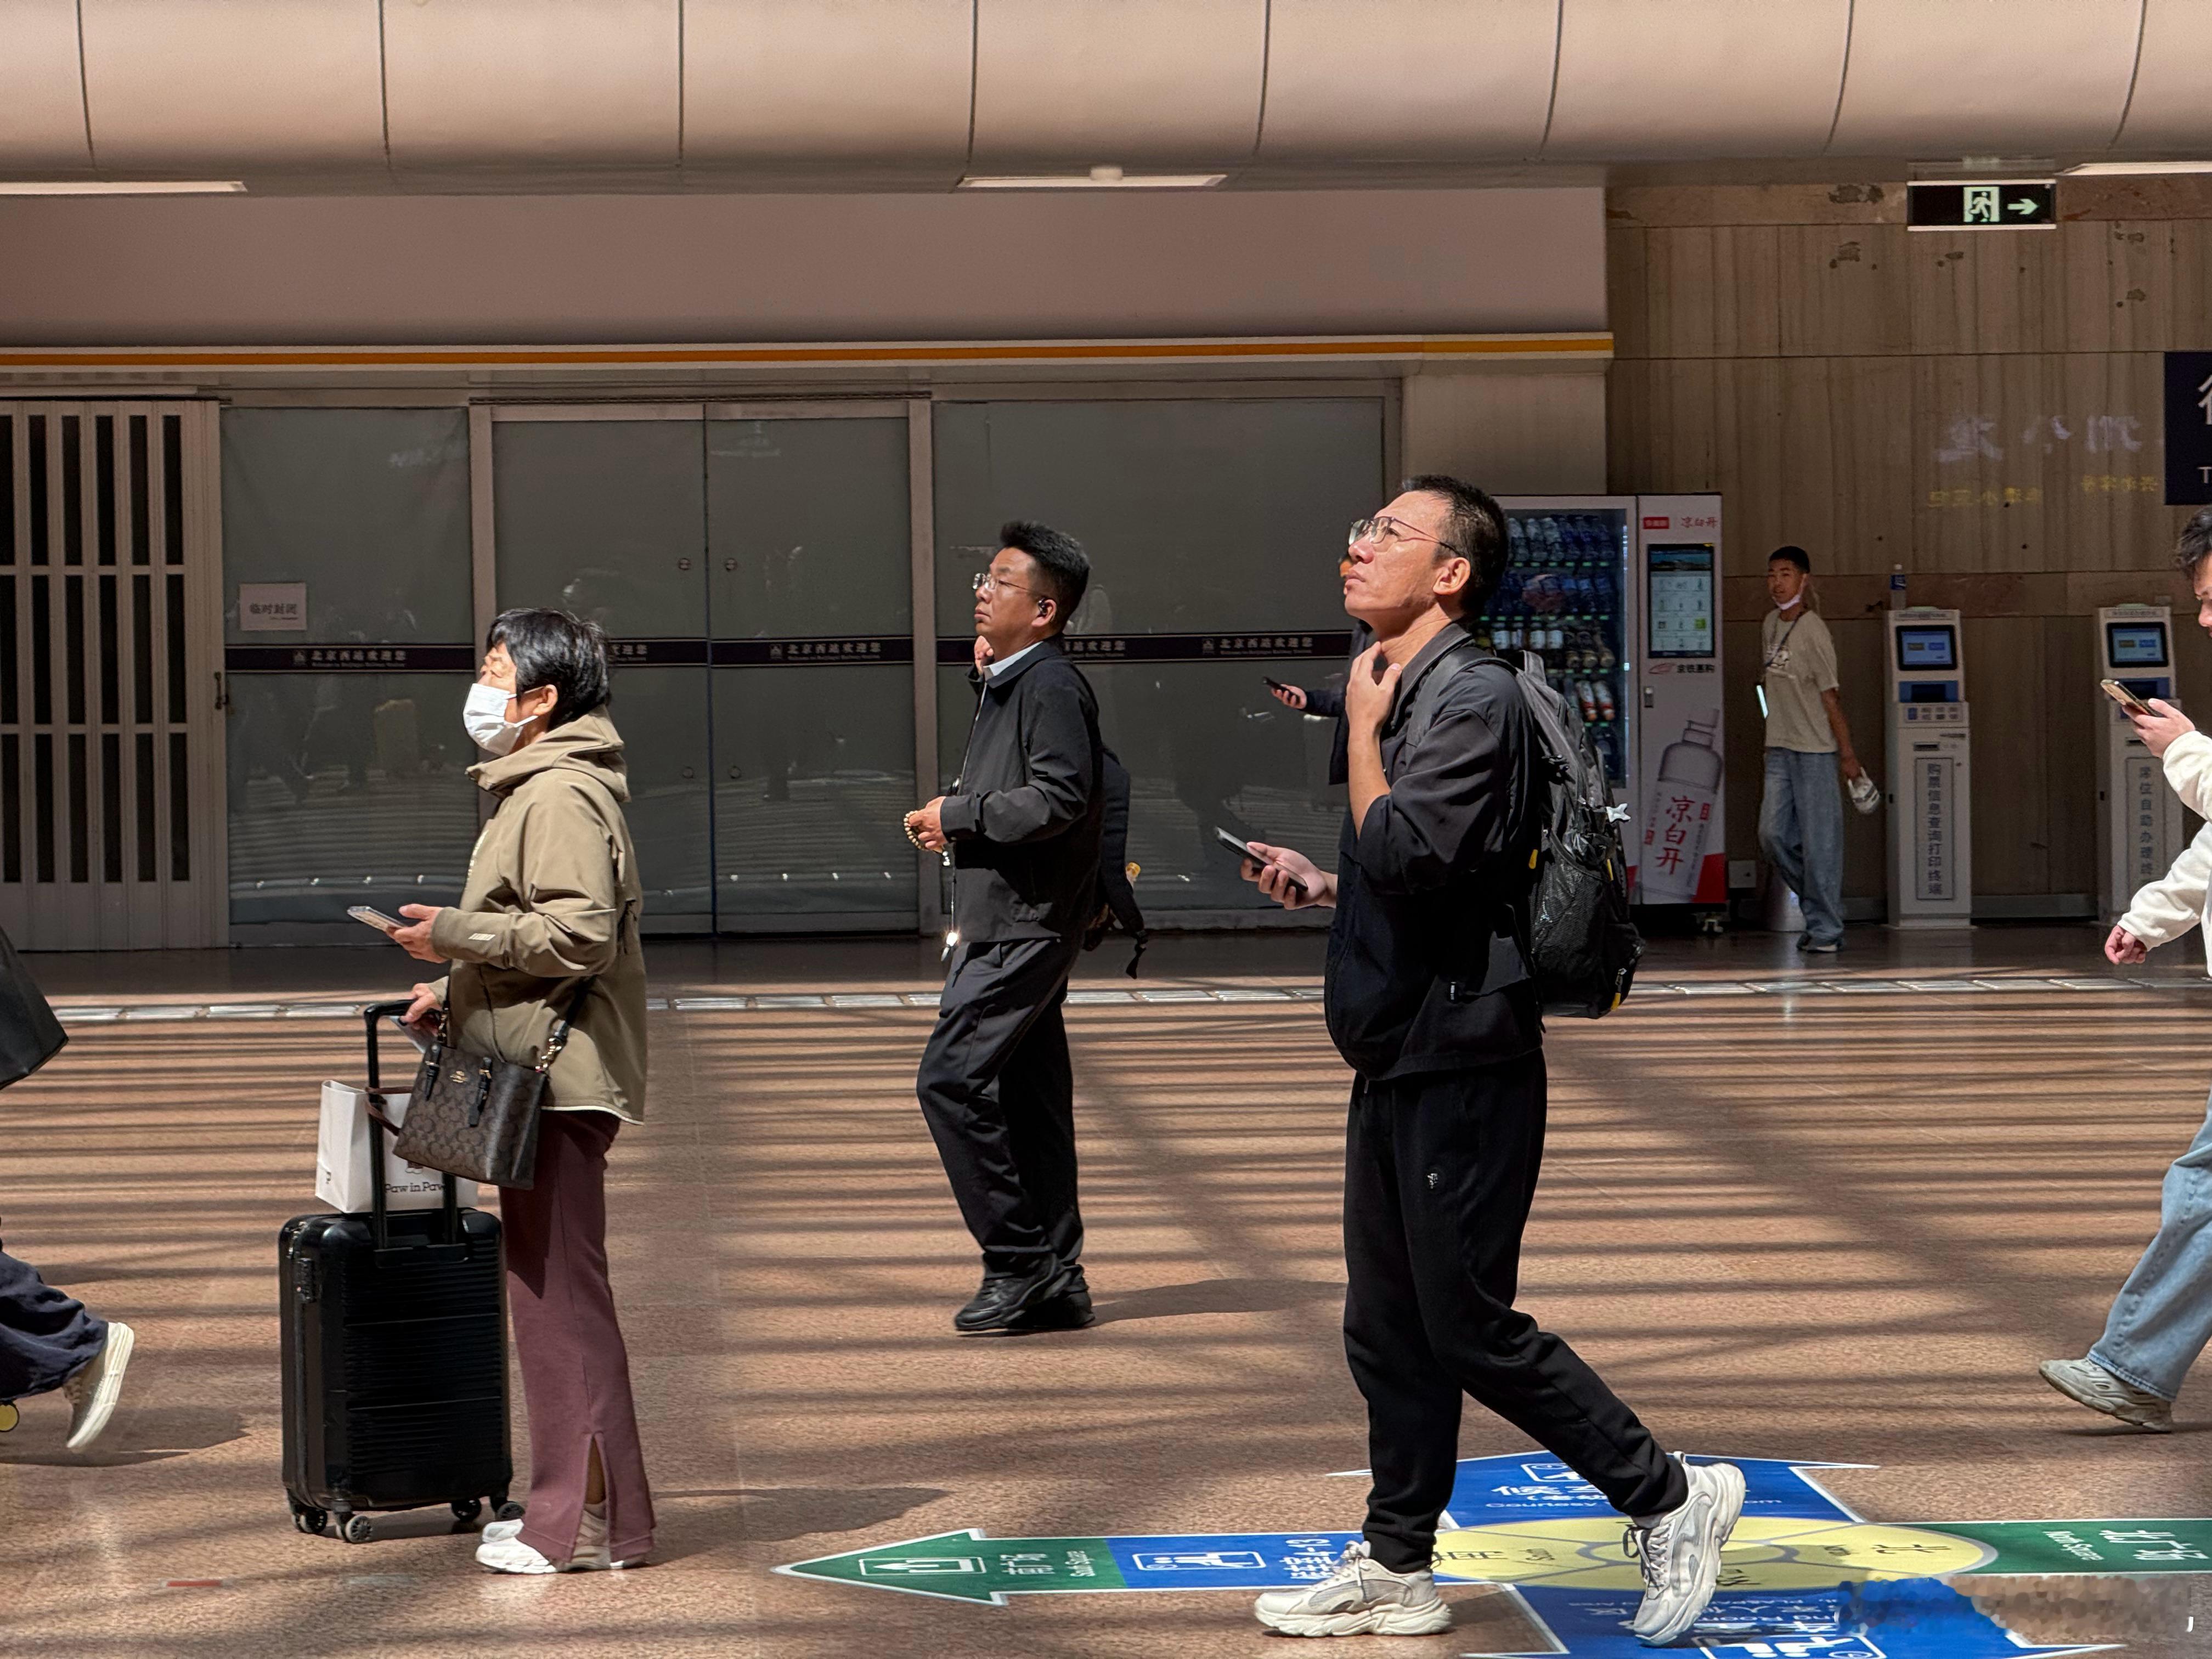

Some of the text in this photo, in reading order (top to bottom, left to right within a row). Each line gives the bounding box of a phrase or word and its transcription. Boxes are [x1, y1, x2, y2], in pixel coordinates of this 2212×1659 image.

[1656, 795, 1696, 875] 凉白开
[410, 1182, 421, 1192] in
[2042, 1531, 2105, 1561] North Square
[2098, 1530, 2210, 1561] 北广场
[999, 1553, 1056, 1575] 南广场
